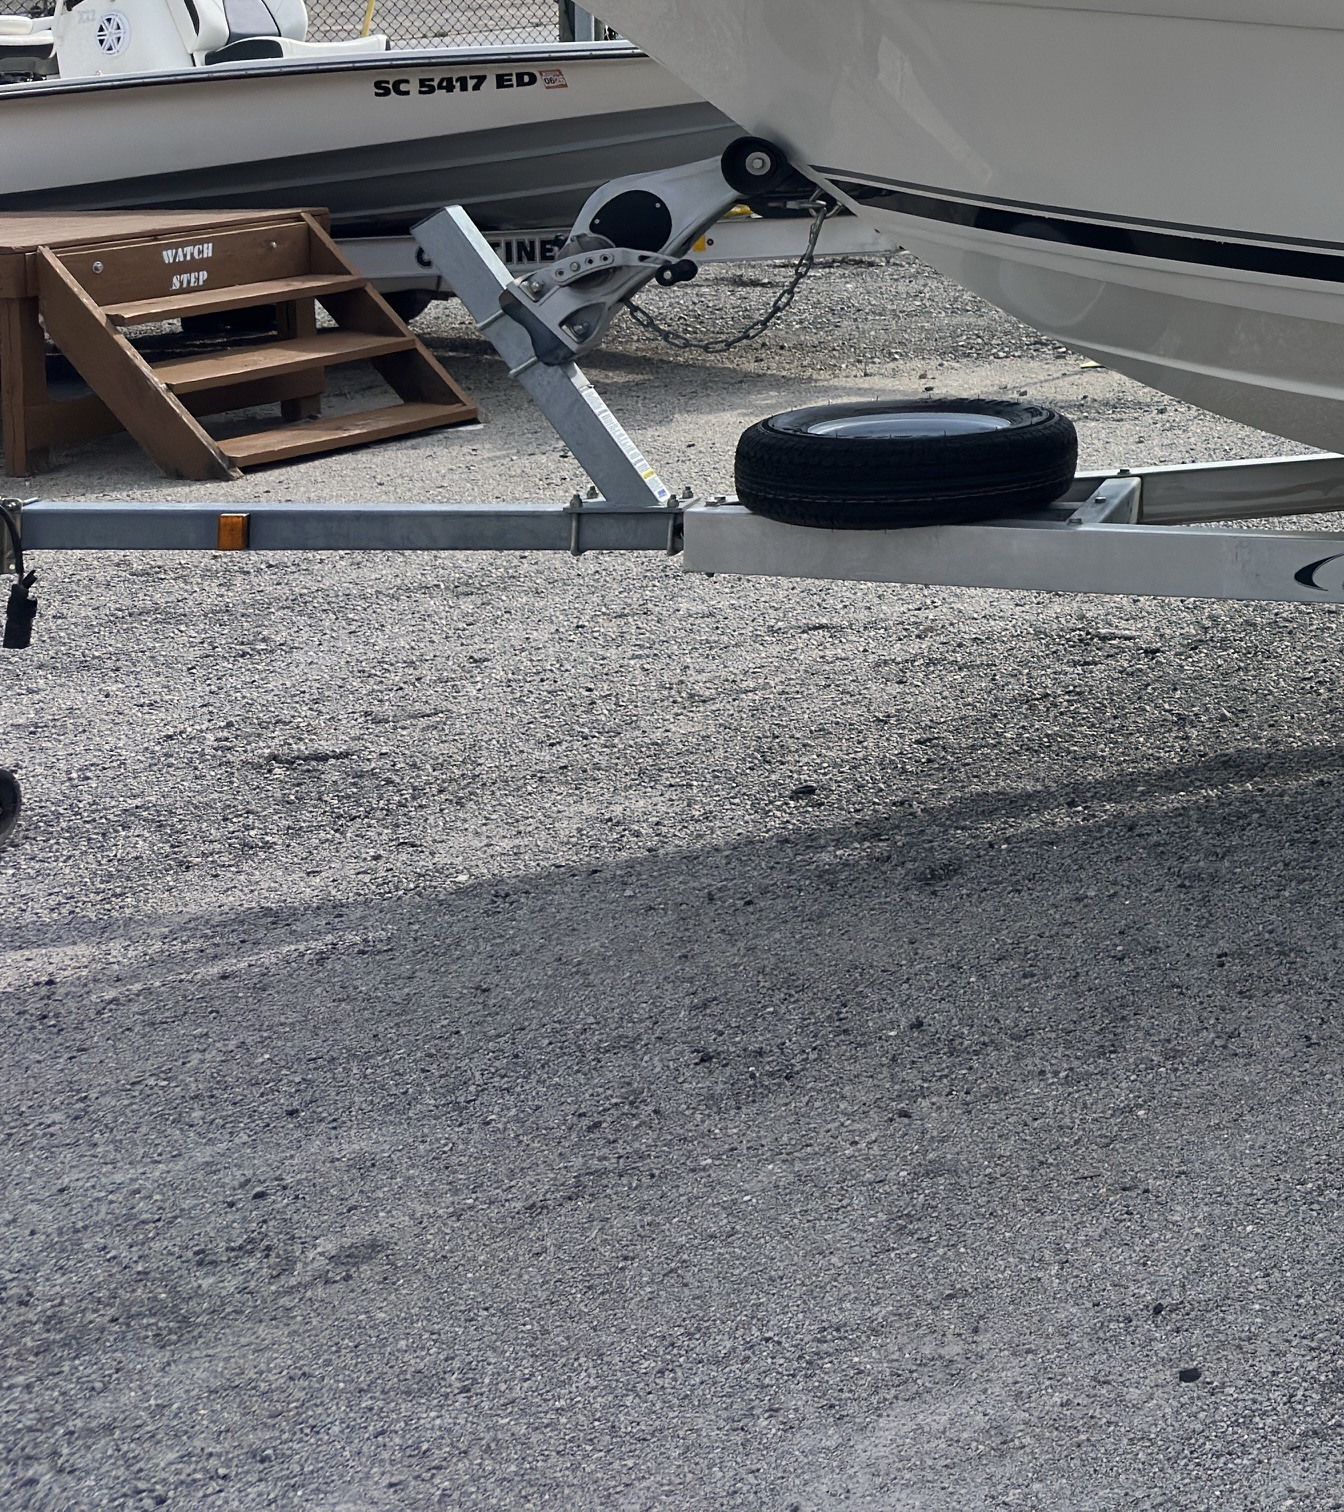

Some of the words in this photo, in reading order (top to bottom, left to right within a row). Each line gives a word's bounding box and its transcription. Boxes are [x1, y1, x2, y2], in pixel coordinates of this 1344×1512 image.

[373, 79, 410, 97] SC
[418, 74, 487, 95] 5417
[495, 71, 538, 89] ED
[162, 242, 213, 264] WATCH
[171, 270, 208, 290] STEP
